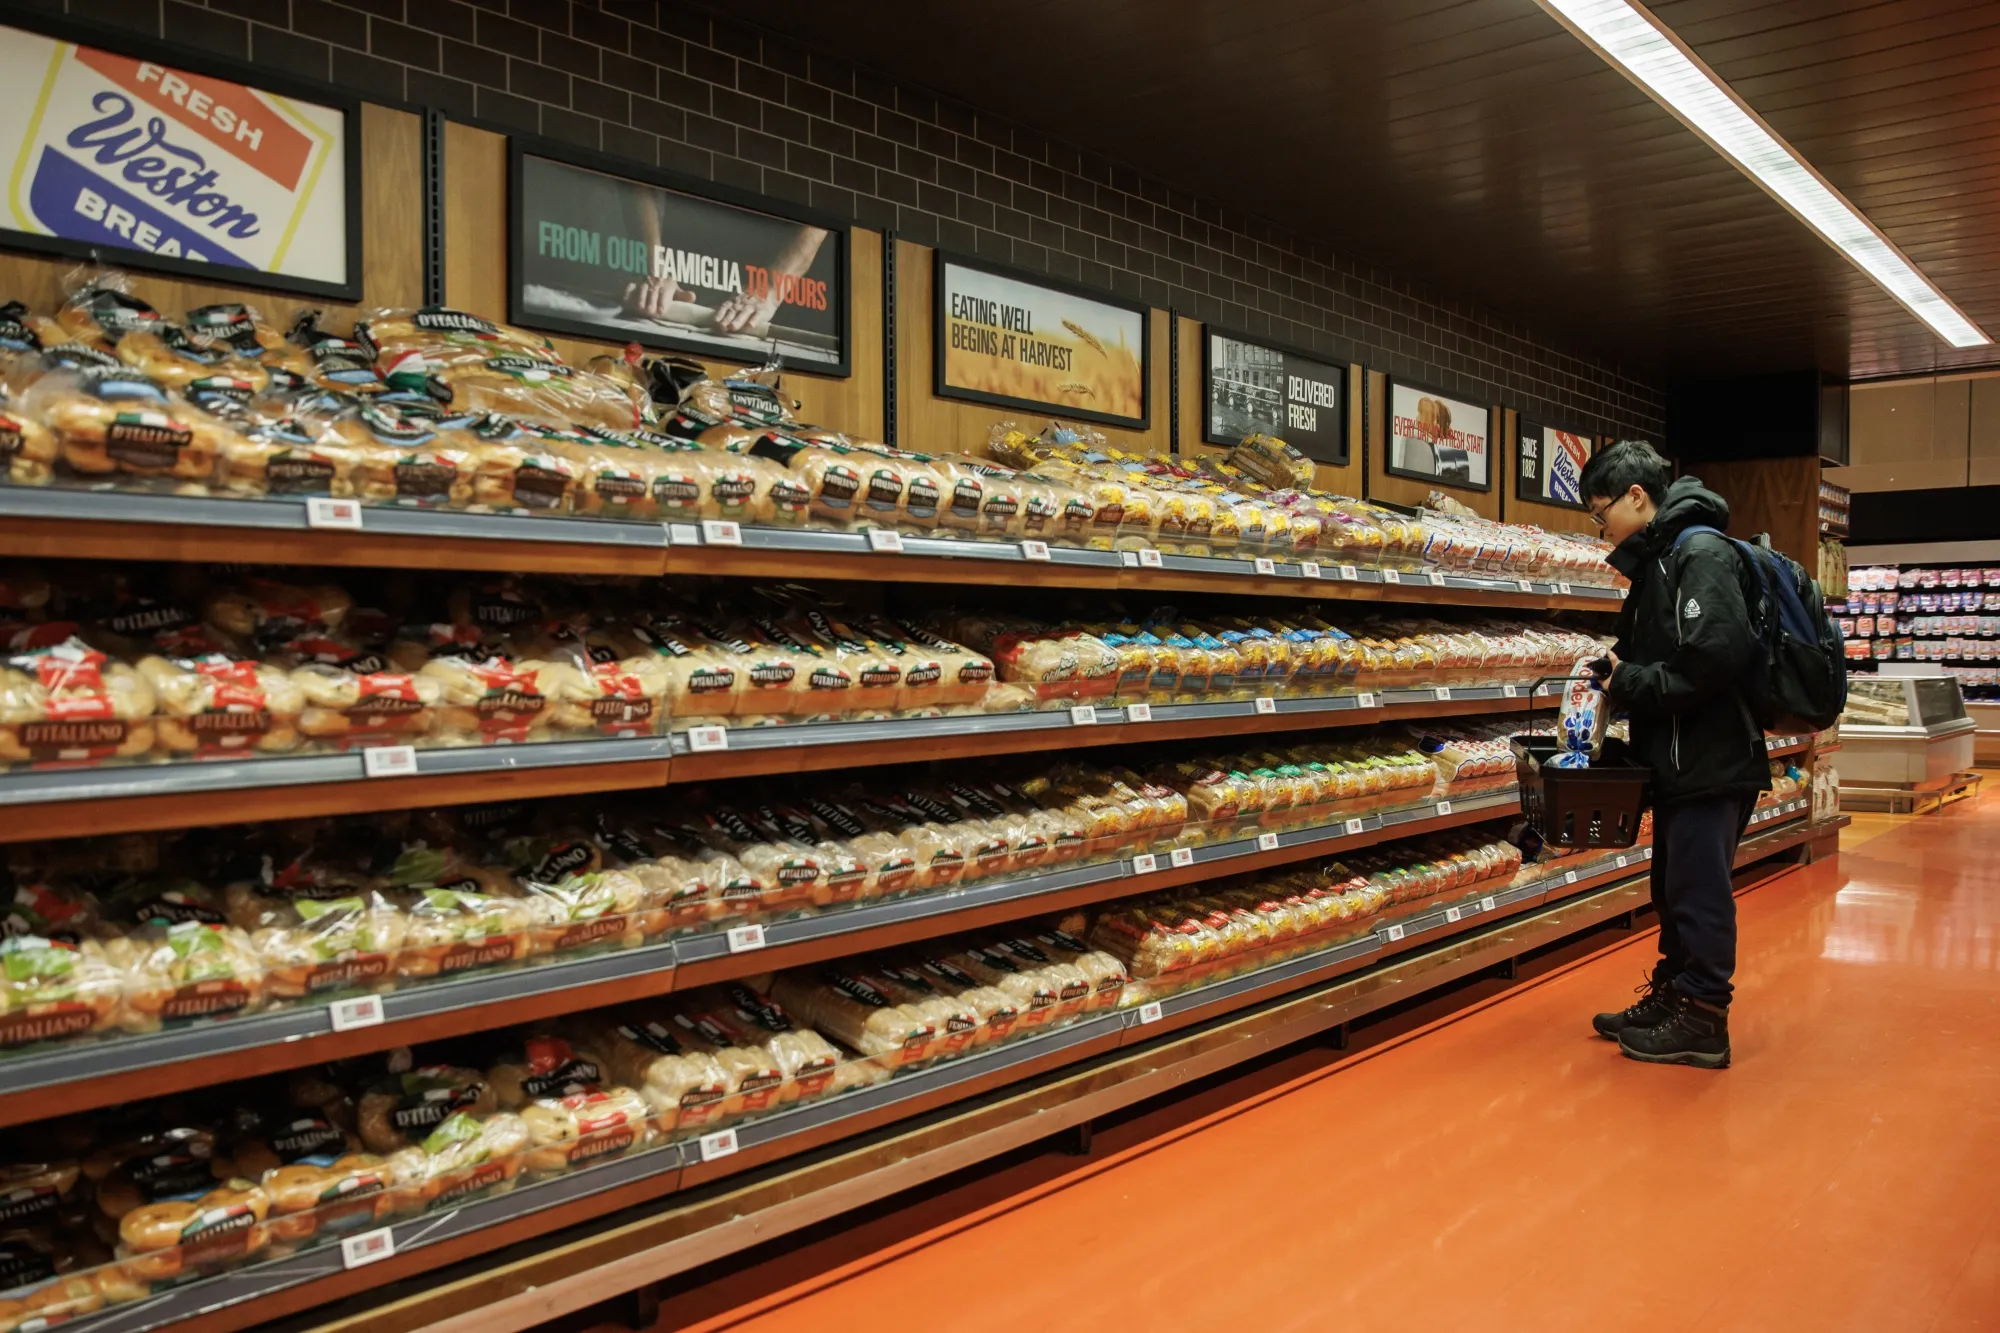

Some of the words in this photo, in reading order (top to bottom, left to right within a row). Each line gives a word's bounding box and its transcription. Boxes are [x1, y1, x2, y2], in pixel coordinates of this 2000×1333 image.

[136, 62, 264, 151] FRESH
[67, 92, 260, 239] Weston
[539, 220, 600, 266] FROM
[606, 235, 647, 275] OUR
[654, 244, 742, 294] FAMIGLIA
[745, 264, 768, 300] TO
[773, 270, 827, 311] YOURS
[952, 292, 997, 327] EATING
[1000, 303, 1033, 335] WELL
[952, 323, 997, 356] BEGINS
[1001, 333, 1016, 360] AT
[1020, 338, 1072, 372] HARVEST
[1288, 375, 1334, 409] DELIVERED
[1288, 403, 1316, 432] FRESH
[1394, 415, 1416, 439] EVERY
[1446, 427, 1465, 451] FRESH
[1466, 433, 1484, 454] START
[1522, 436, 1537, 459] SINCE
[1563, 432, 1581, 460] FRESH
[1522, 458, 1536, 479] 1882
[1554, 445, 1580, 493] Weston
[26, 724, 123, 743] D'ITALIANO
